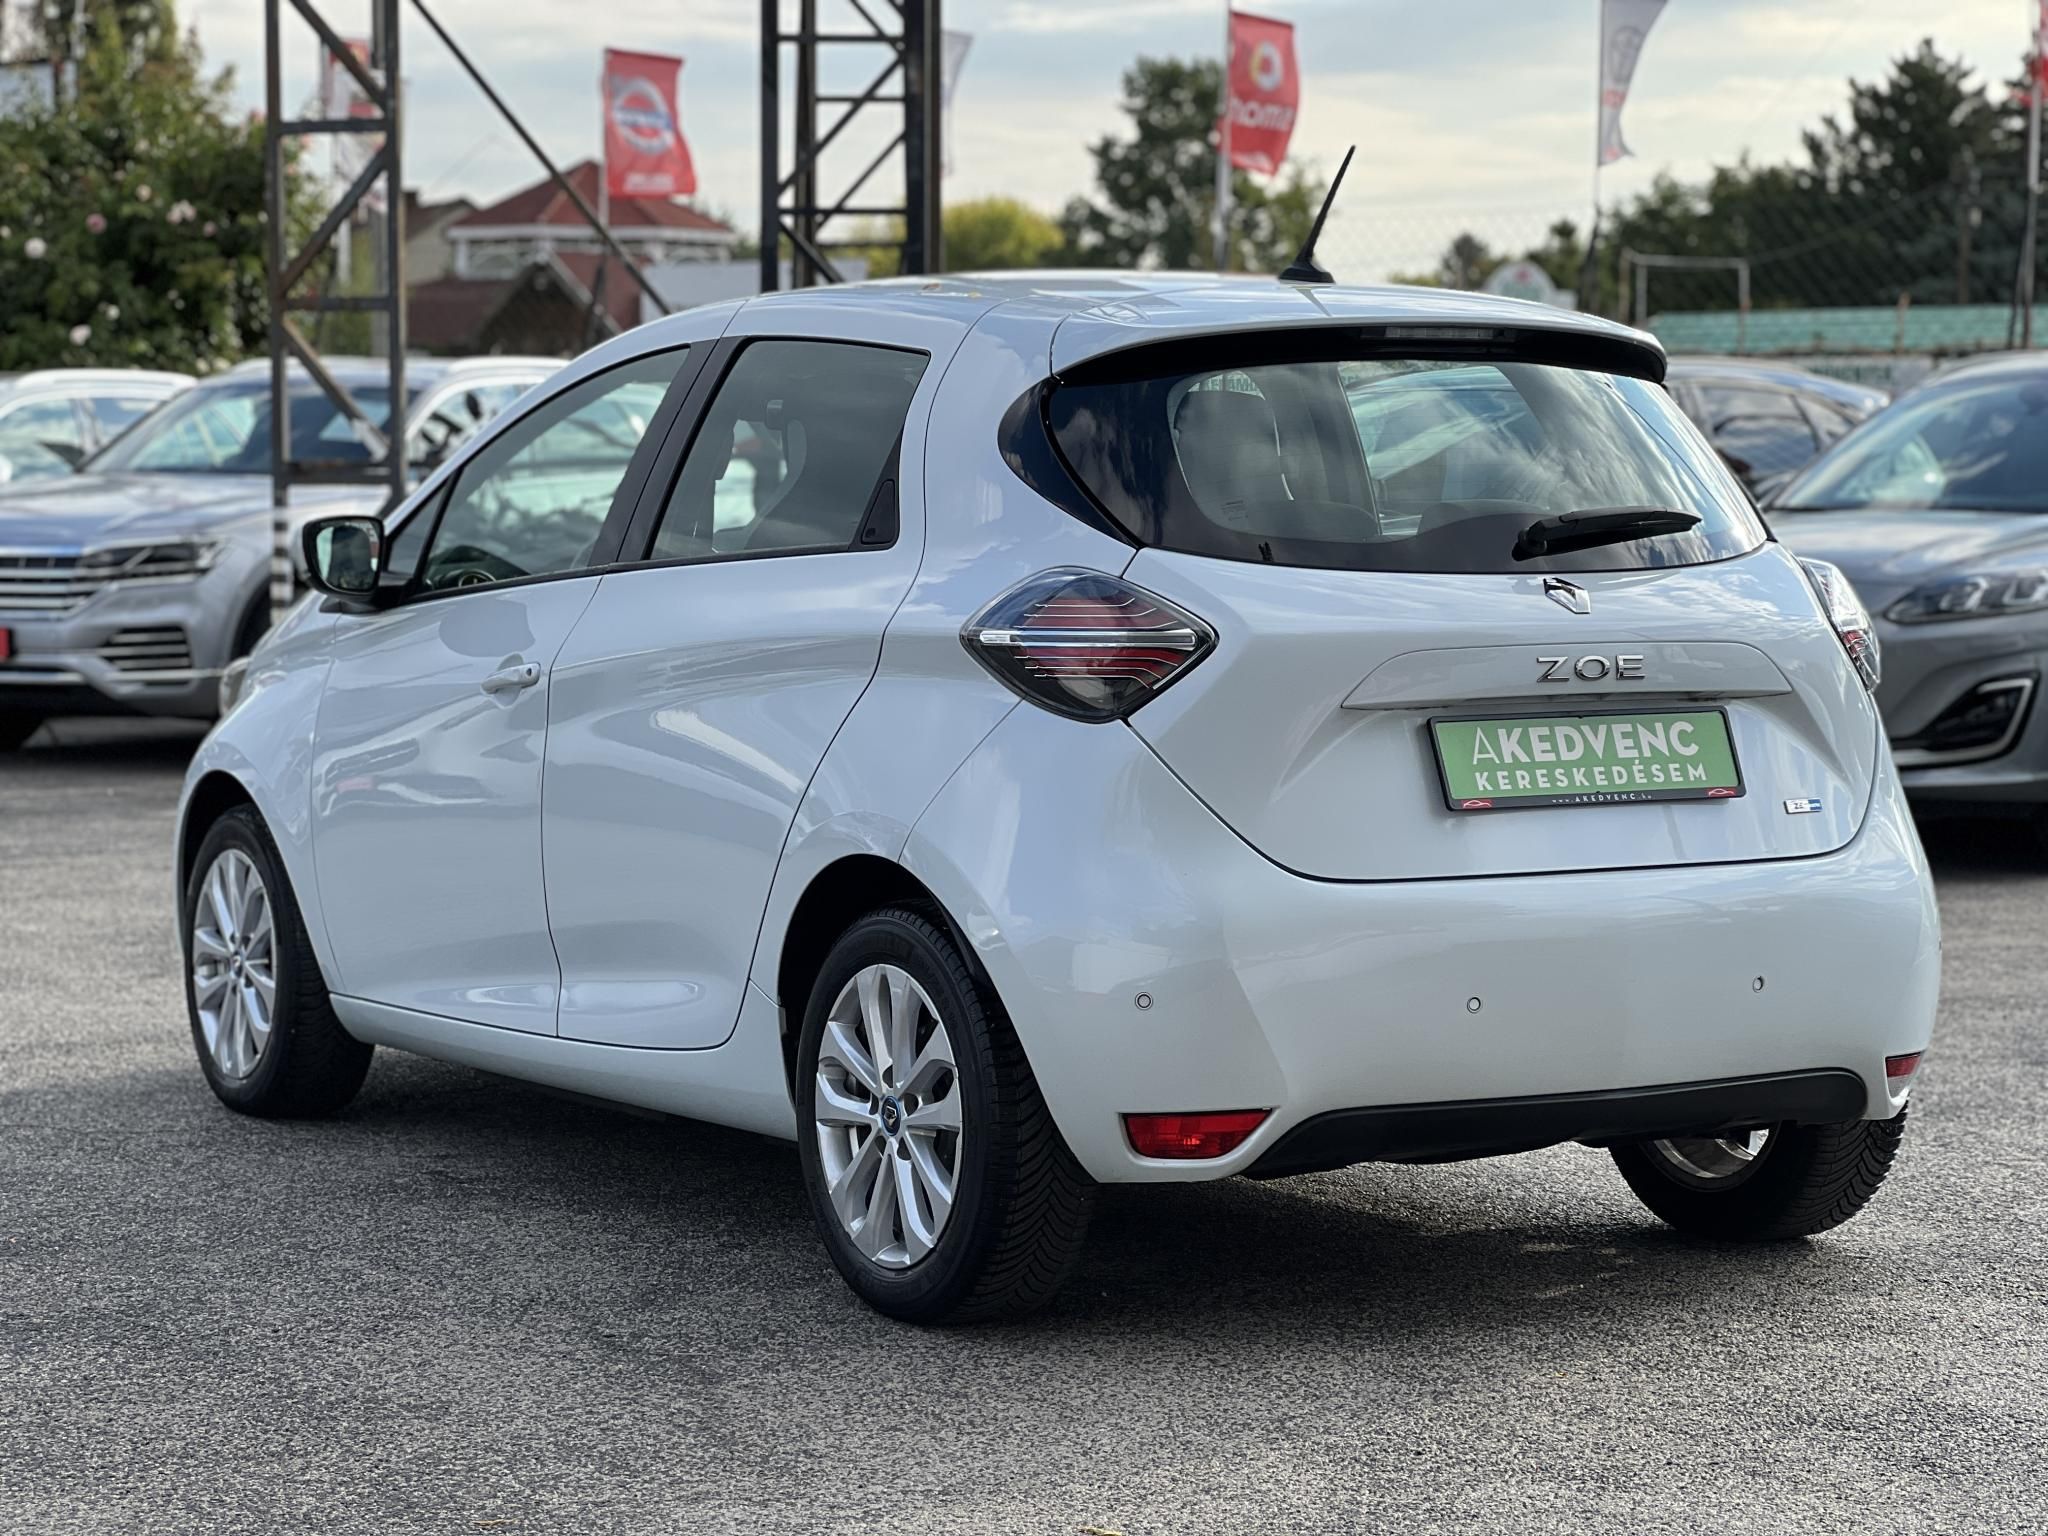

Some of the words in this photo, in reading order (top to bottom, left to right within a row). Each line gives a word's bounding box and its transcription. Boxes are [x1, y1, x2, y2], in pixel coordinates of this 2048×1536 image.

[1537, 655, 1646, 682] ZOE
[1472, 721, 1700, 765] AKEDVENC
[1475, 760, 1708, 791] KERESKEDÉSEM
